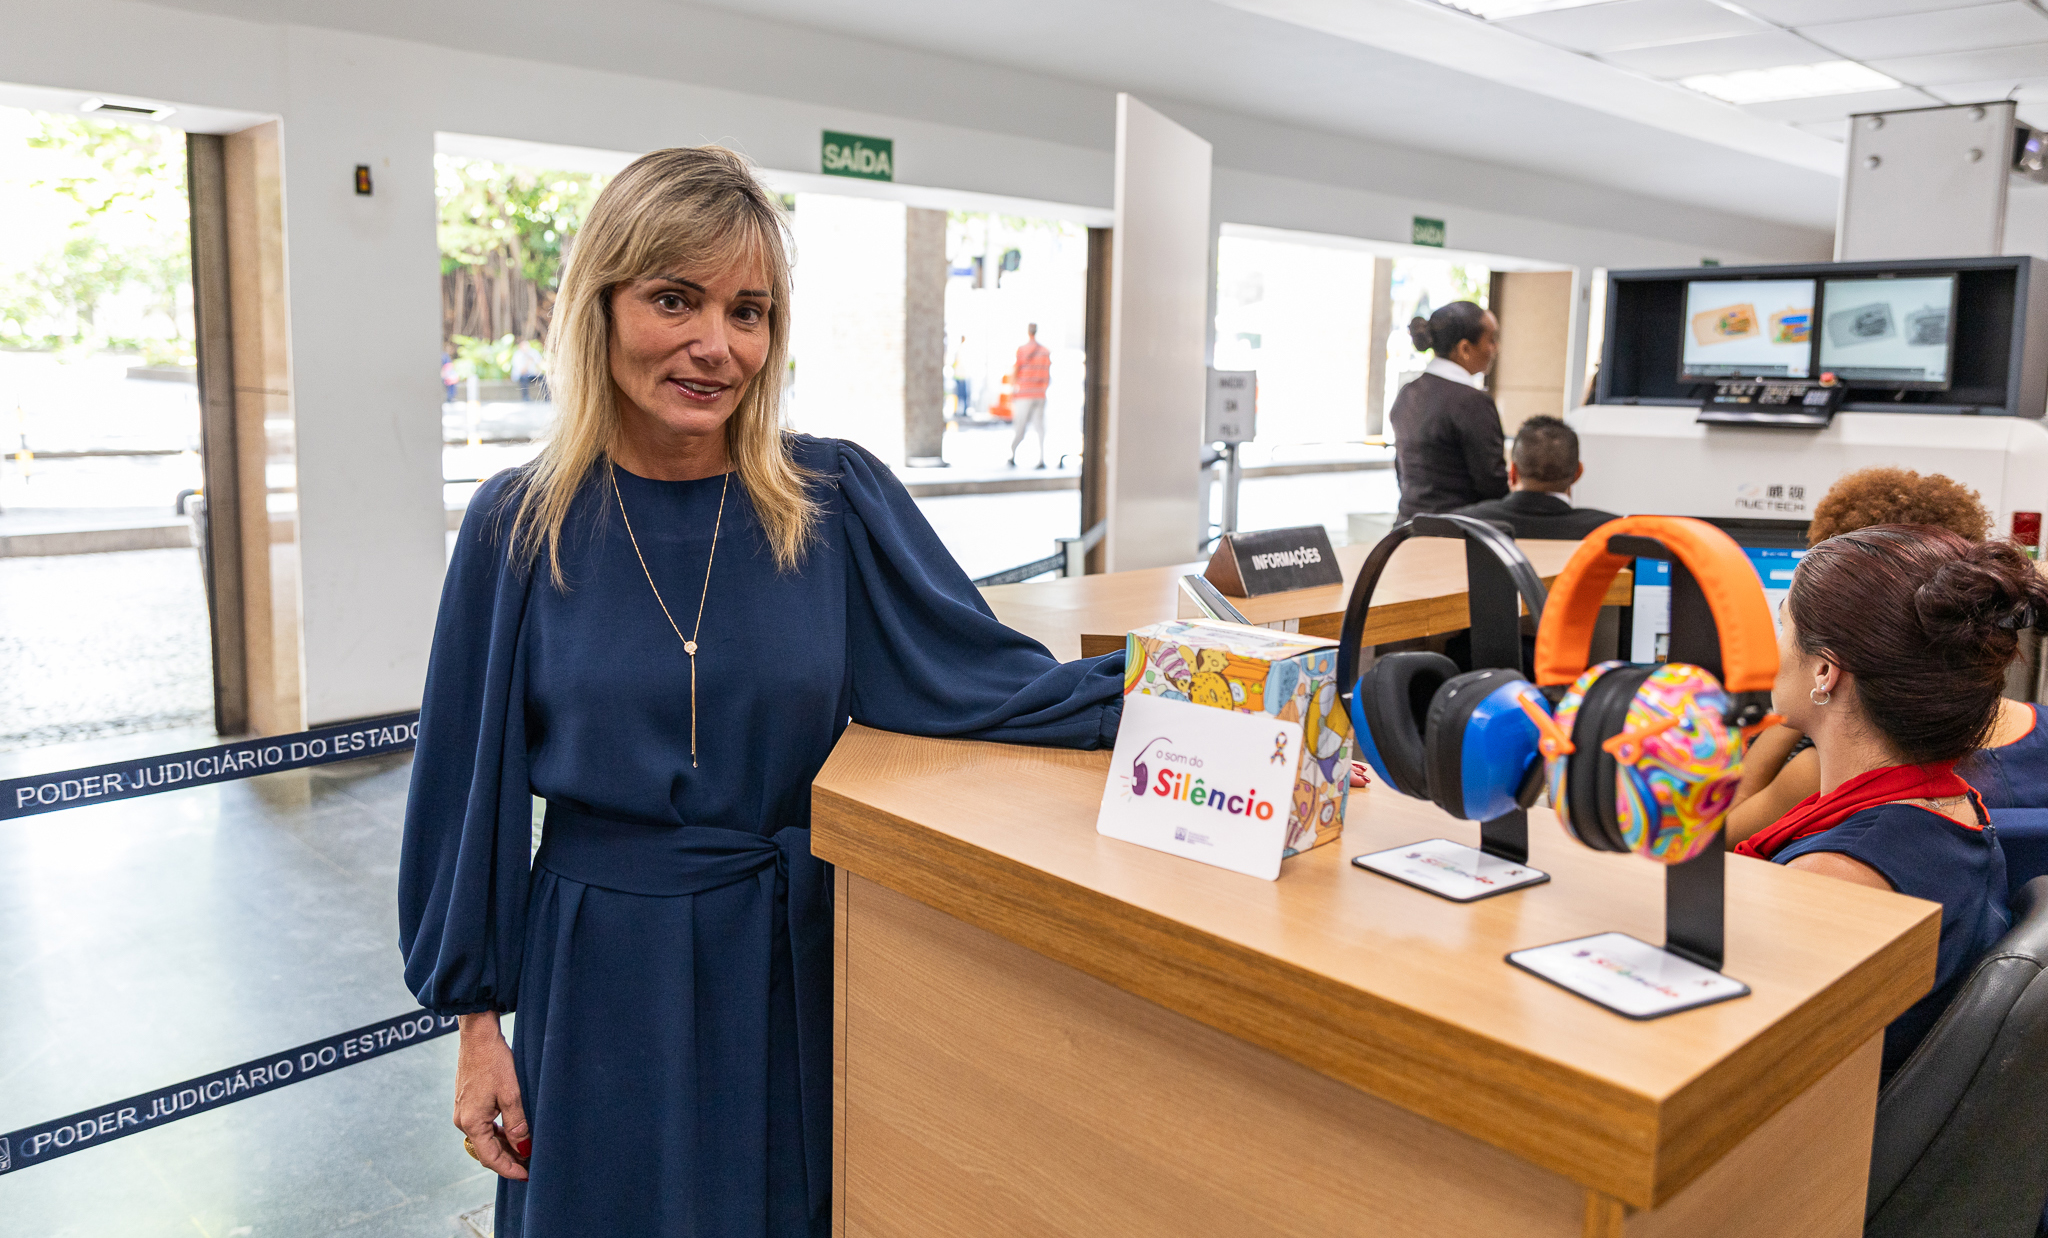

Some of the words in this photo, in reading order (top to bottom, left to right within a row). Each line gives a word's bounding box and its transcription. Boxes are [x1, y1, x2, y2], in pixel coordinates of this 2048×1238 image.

[824, 140, 891, 176] SAÍDA
[1251, 546, 1321, 571] INFORMAÇÕES
[16, 772, 124, 809] PODER
[131, 746, 283, 790] JUDICIÁRIO
[290, 738, 327, 762] DO
[1164, 752, 1188, 765] som
[1189, 755, 1204, 768] do
[1153, 768, 1274, 820] Silêncio
[34, 1106, 139, 1156] PODER
[146, 1059, 294, 1121] JUDICIÁRIO
[300, 1046, 337, 1073] DO
[343, 1015, 435, 1060] ESTADO
